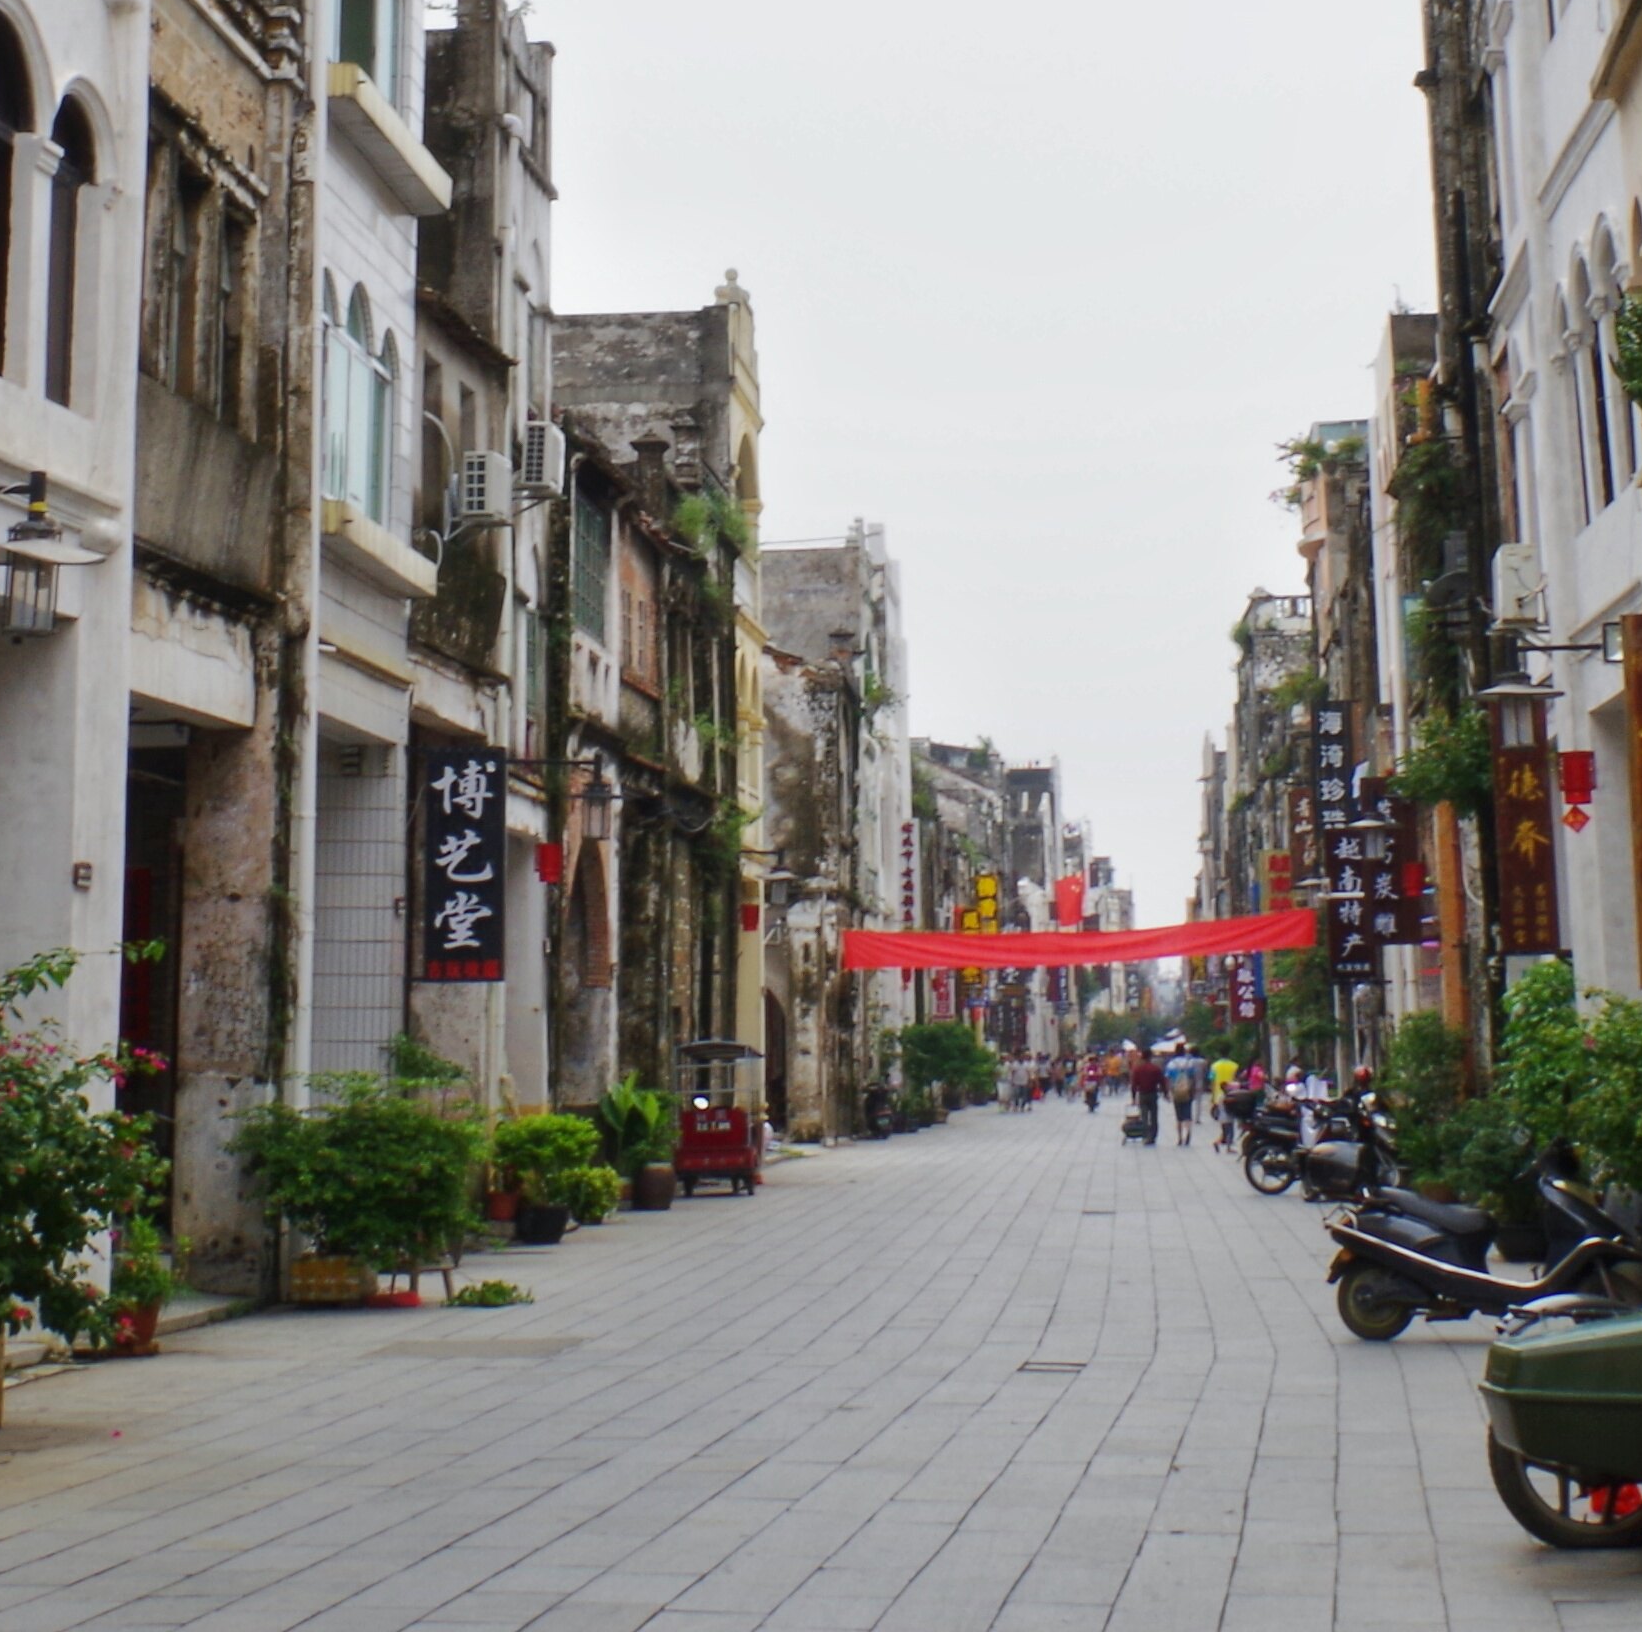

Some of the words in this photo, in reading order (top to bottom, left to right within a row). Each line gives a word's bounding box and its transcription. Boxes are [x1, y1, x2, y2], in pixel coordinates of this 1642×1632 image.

[431, 759, 496, 950] 博艺堂
[1334, 836, 1365, 957] 越南特产
